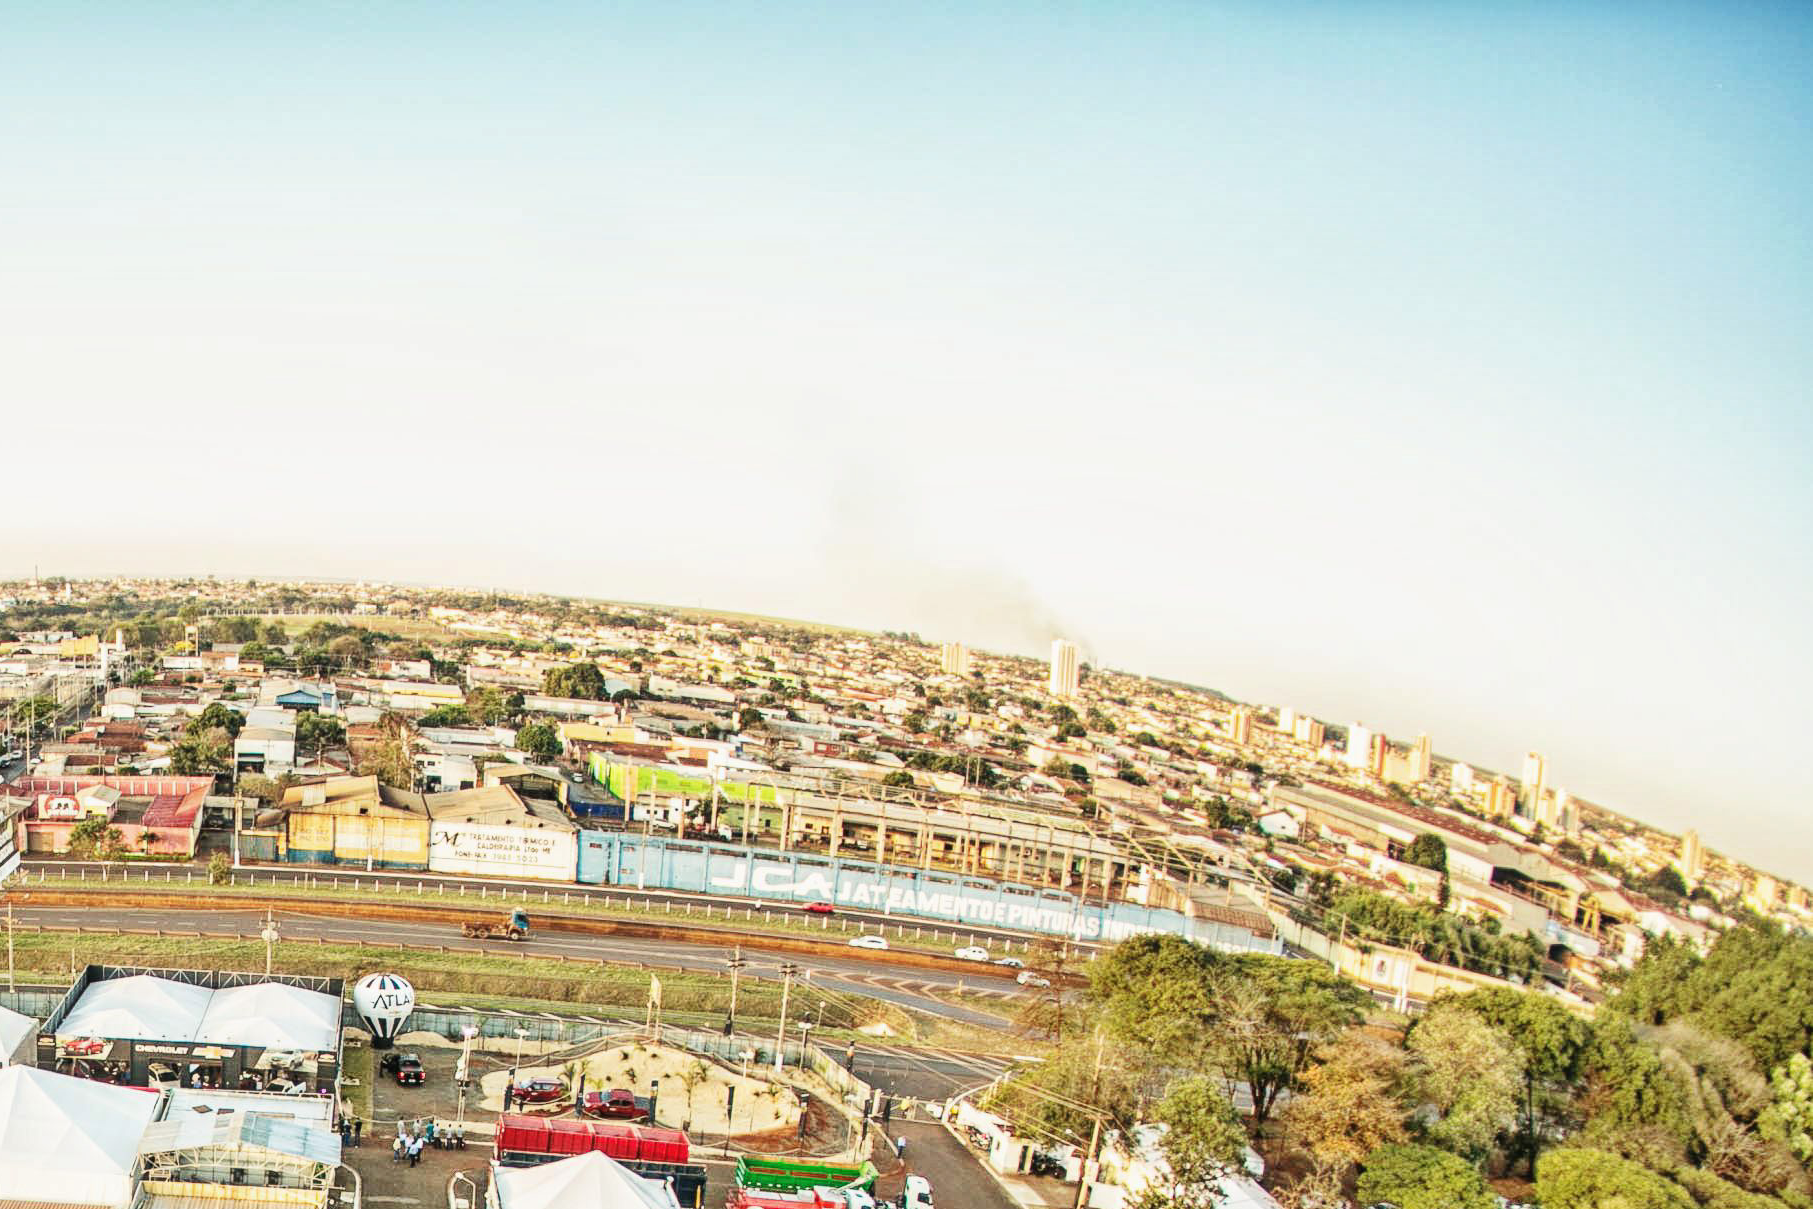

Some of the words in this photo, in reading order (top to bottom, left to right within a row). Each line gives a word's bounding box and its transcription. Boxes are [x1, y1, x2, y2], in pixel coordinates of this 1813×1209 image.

[469, 833, 515, 844] TRATAMENTO
[710, 863, 834, 899] JCA
[835, 880, 996, 923] JATEAMENTO
[1007, 903, 1100, 938] PINTURAS
[135, 1044, 189, 1055] CHEVROLET
